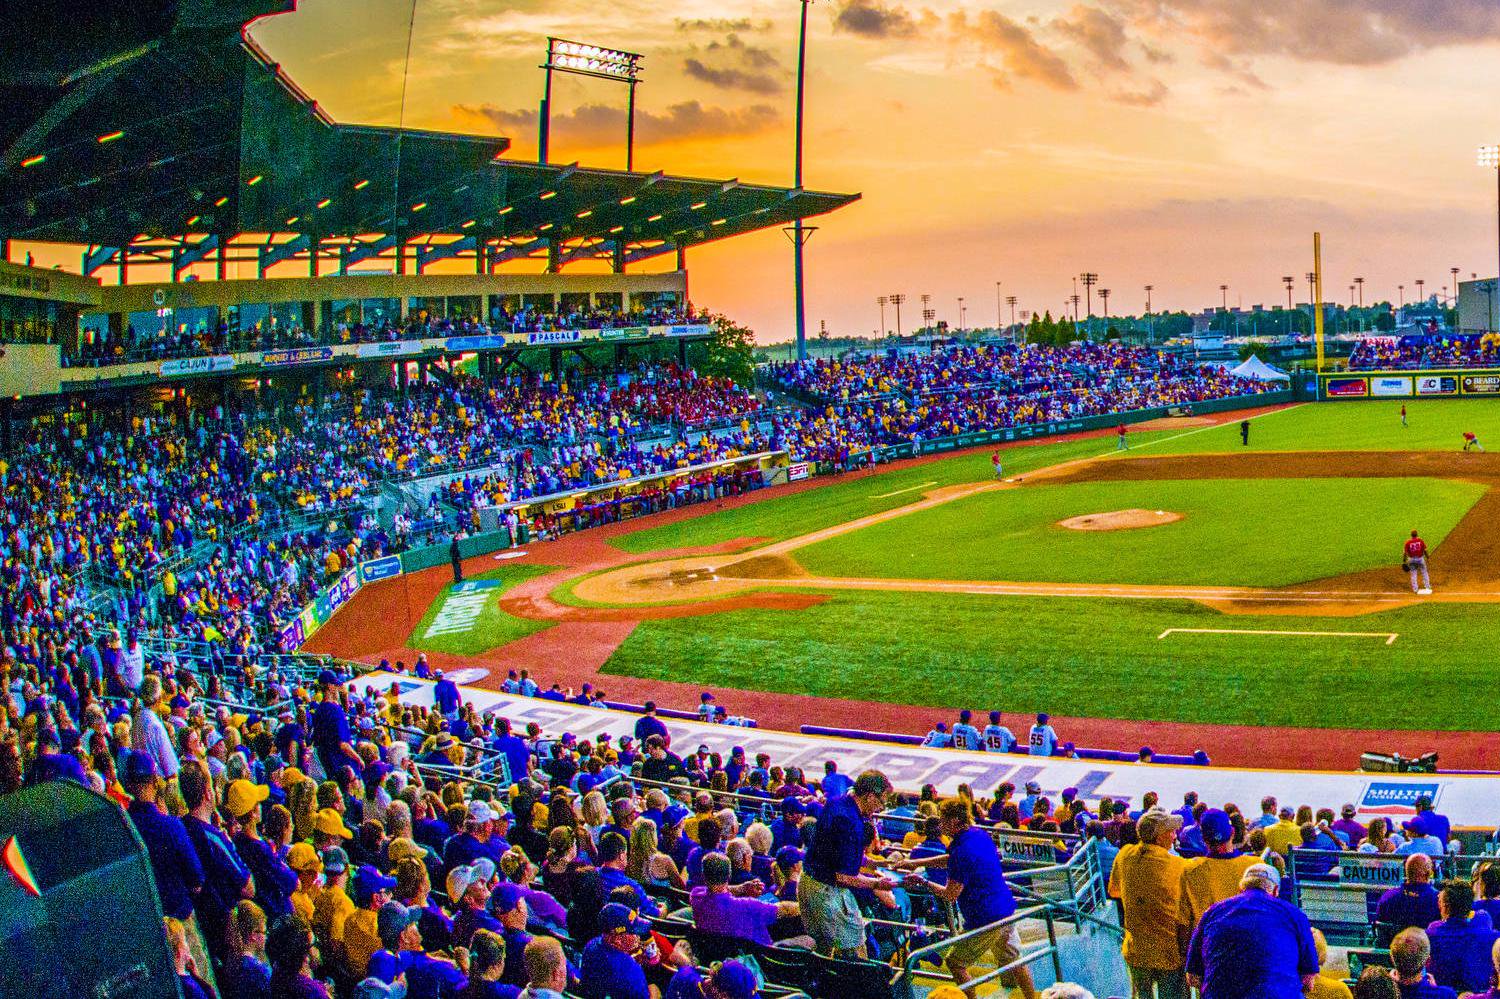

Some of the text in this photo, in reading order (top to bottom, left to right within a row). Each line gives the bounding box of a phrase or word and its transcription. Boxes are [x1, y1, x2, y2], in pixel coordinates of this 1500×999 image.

[538, 332, 571, 341] PASCAL
[788, 464, 808, 475] ESPN
[956, 735, 967, 747] 21
[986, 736, 1001, 749] 45
[1030, 733, 1044, 746] 55
[1369, 789, 1433, 797] SHELTER
[1003, 842, 1052, 858] CAUTION
[1343, 865, 1400, 881] CAUTION
